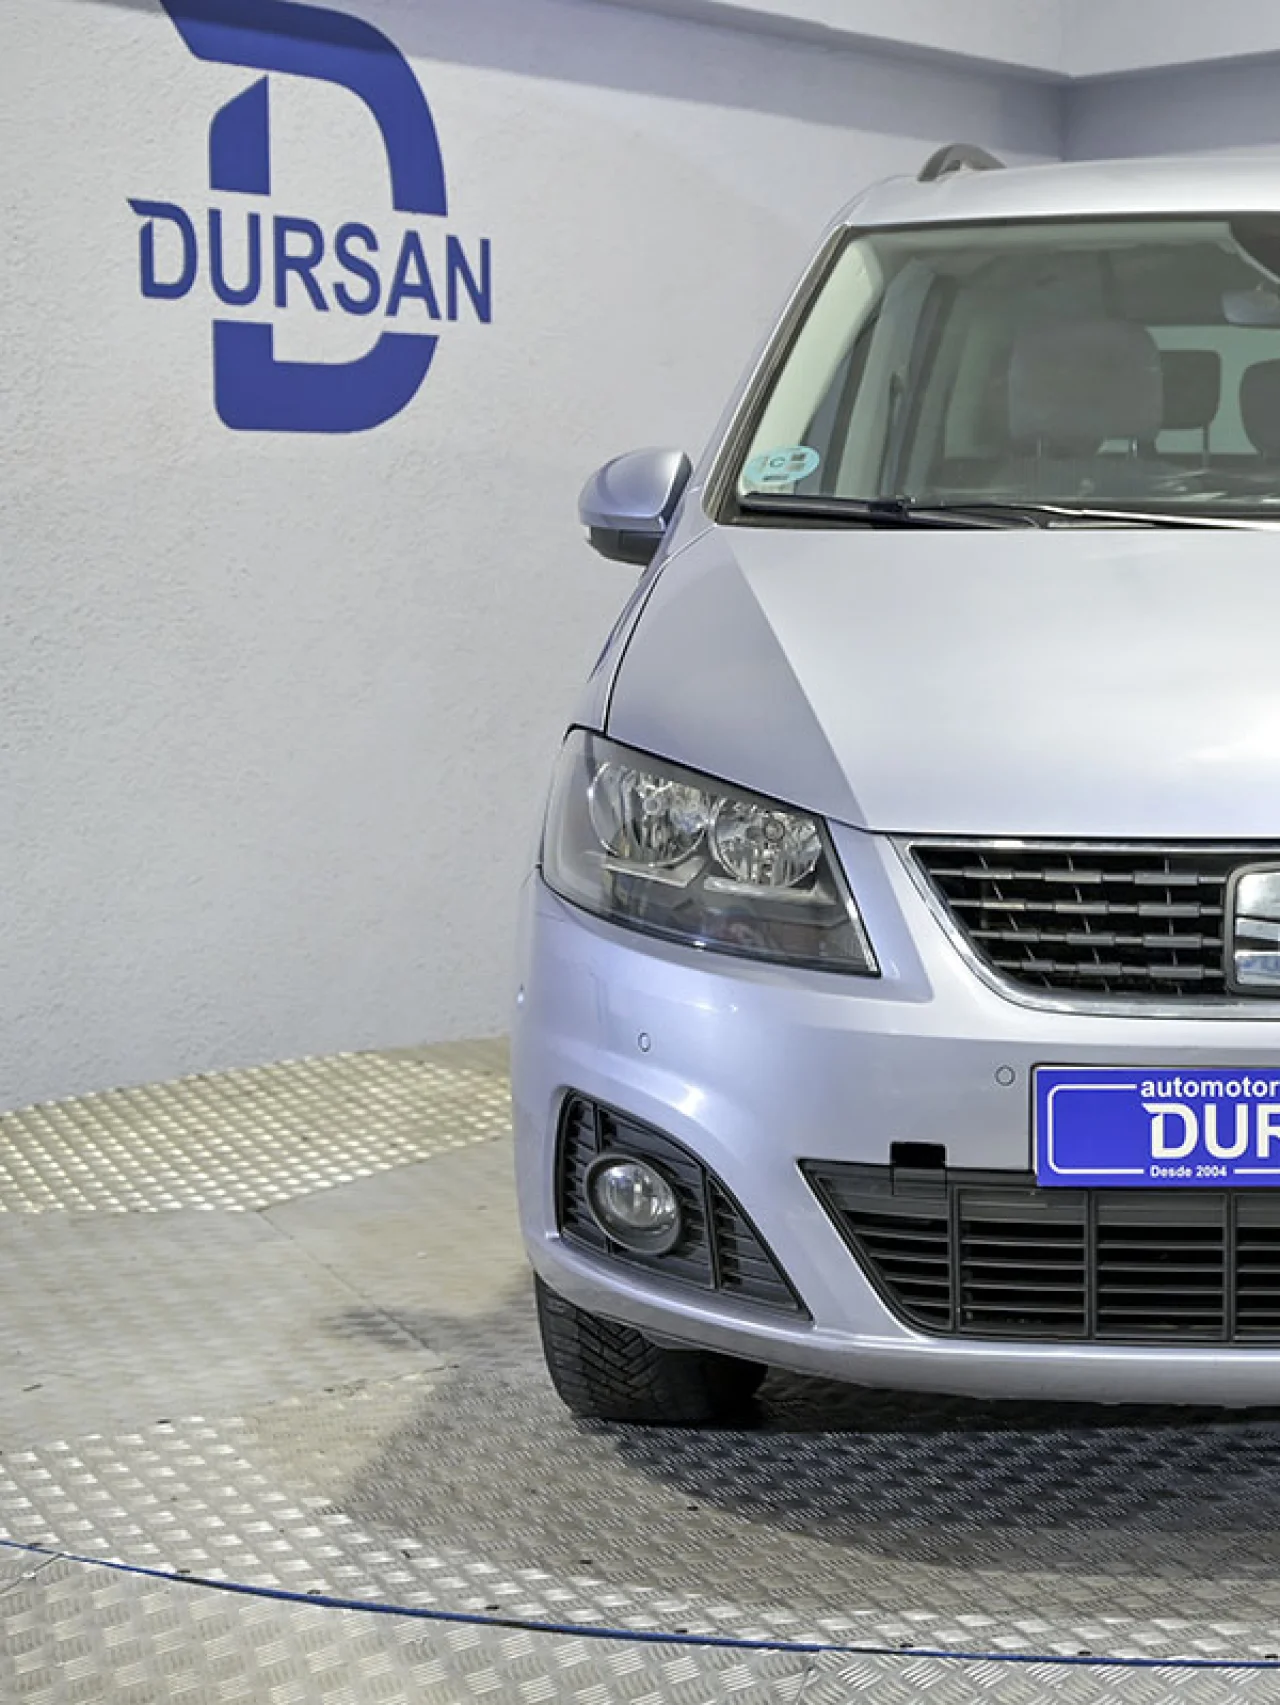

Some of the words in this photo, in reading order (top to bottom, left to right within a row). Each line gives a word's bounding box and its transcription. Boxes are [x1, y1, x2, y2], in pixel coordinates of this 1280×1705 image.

[126, 198, 492, 324] DURSAN
[1140, 1076, 1280, 1098] automotor
[1150, 1165, 1193, 1178] Desde
[1196, 1165, 1228, 1178] 2004
